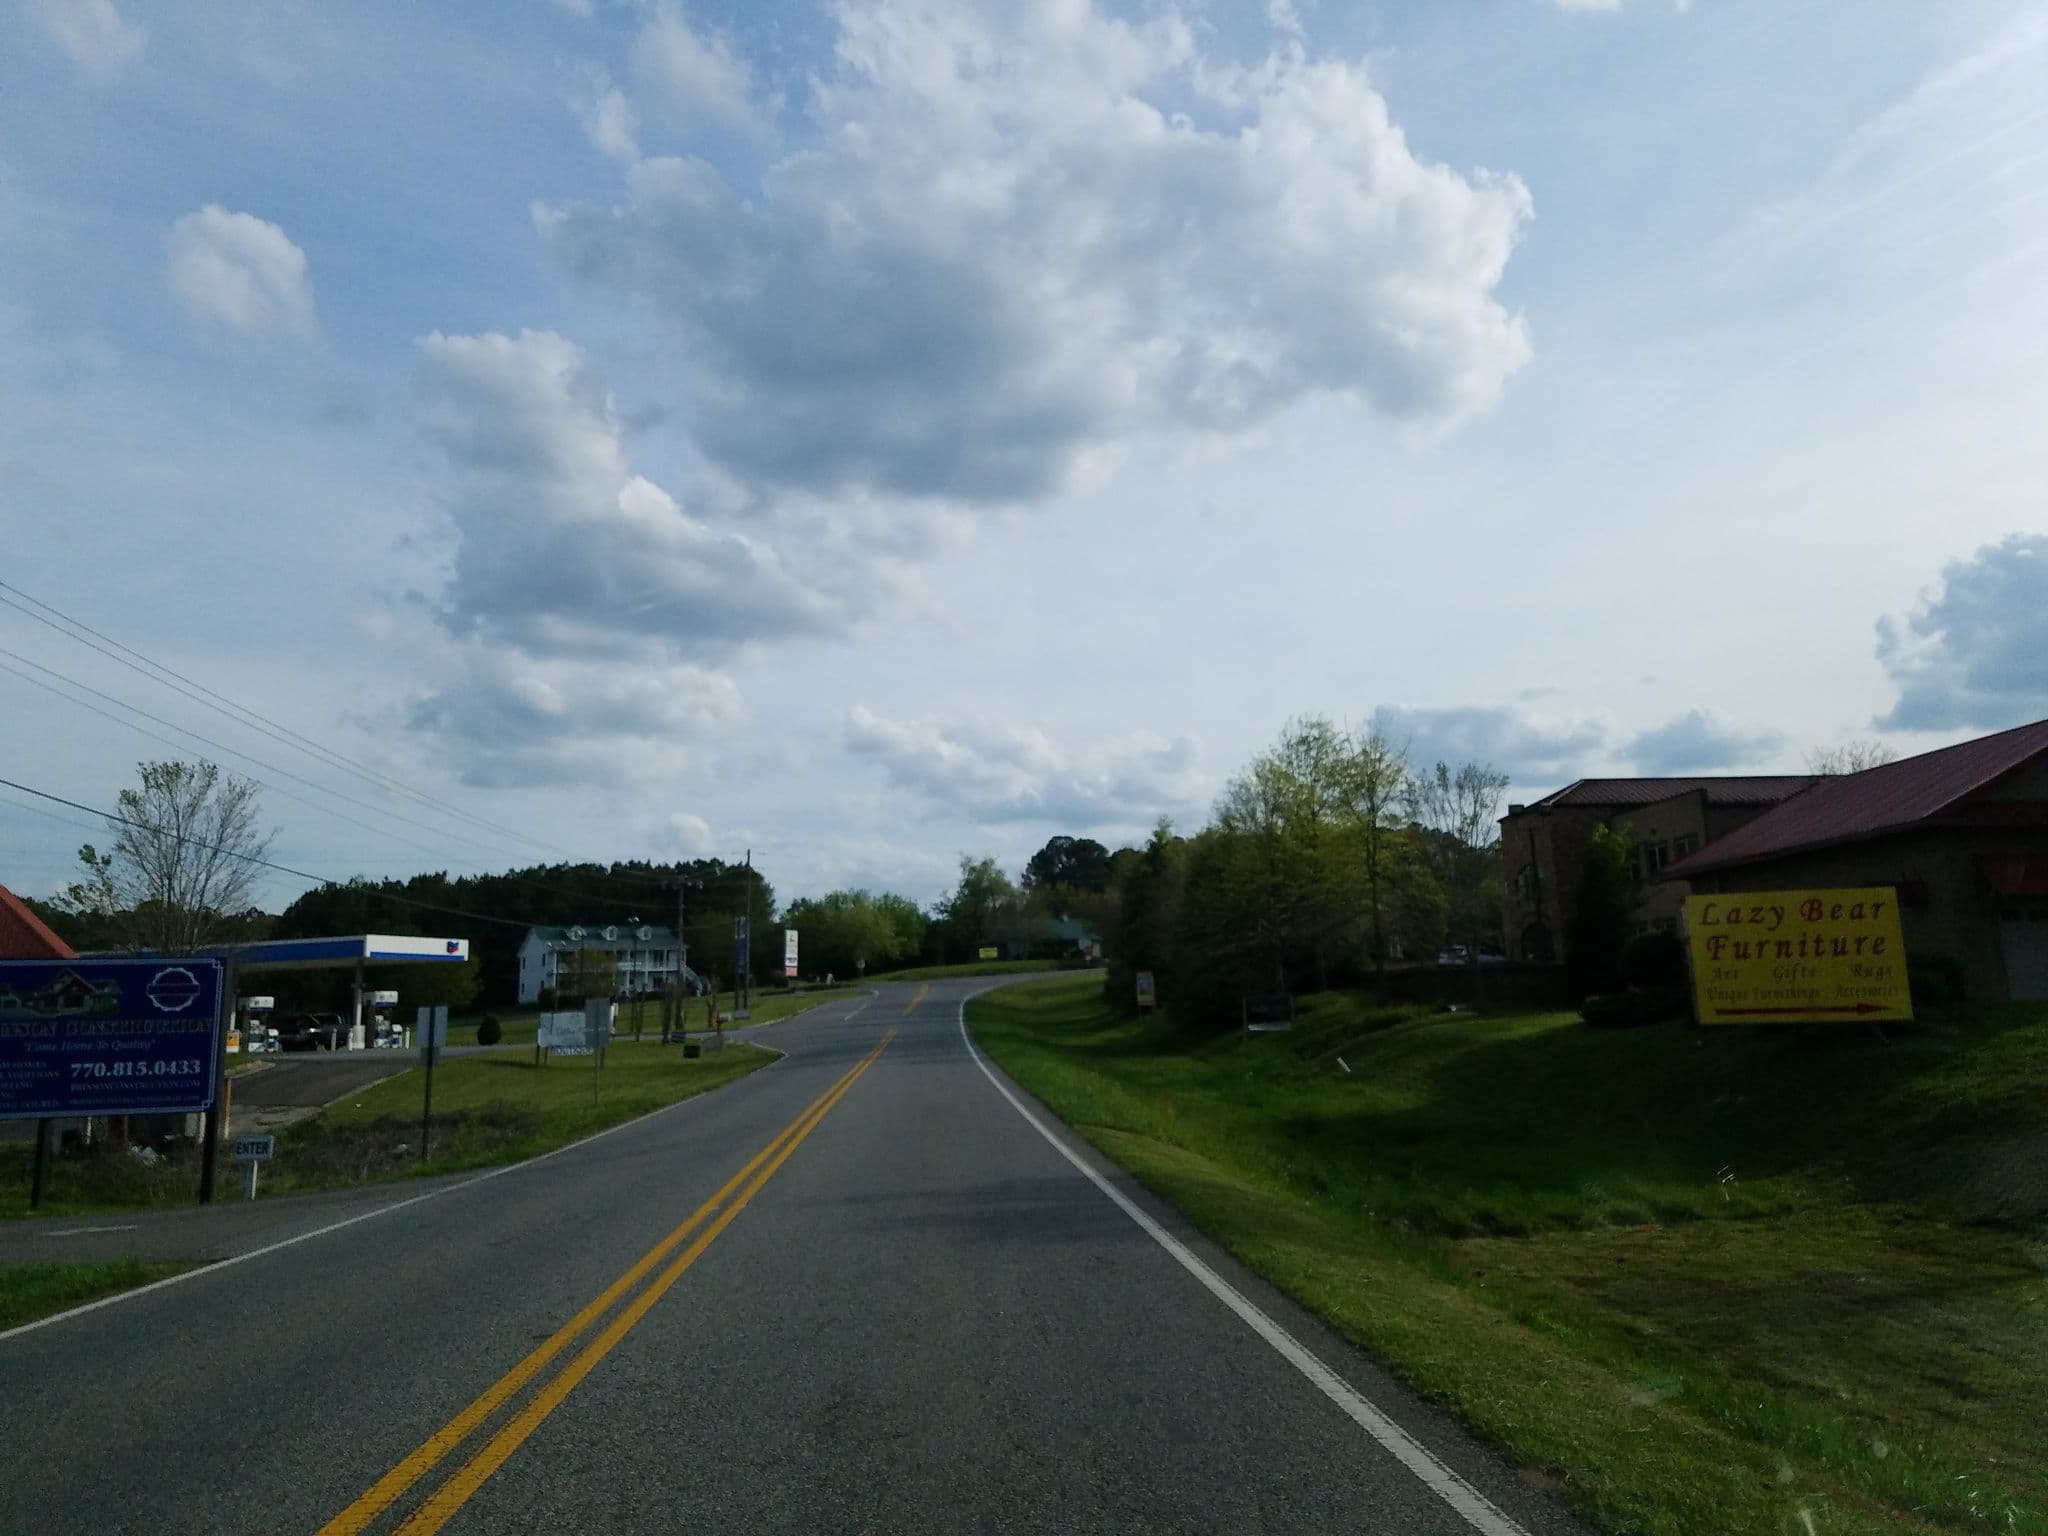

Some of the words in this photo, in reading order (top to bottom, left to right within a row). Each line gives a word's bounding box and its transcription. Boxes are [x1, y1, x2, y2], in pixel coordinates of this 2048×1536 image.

[1699, 902, 1785, 931] Lazy
[1800, 898, 1887, 922] Bear
[1706, 931, 1888, 960] Furniture
[1712, 967, 1740, 980] Art
[1773, 963, 1821, 983] Gifts
[1851, 964, 1893, 981] Rugs
[61, 1041, 95, 1052] Home
[97, 1040, 109, 1051] To
[71, 1060, 201, 1078] 770.815.0433
[236, 1141, 270, 1156] ENTER
